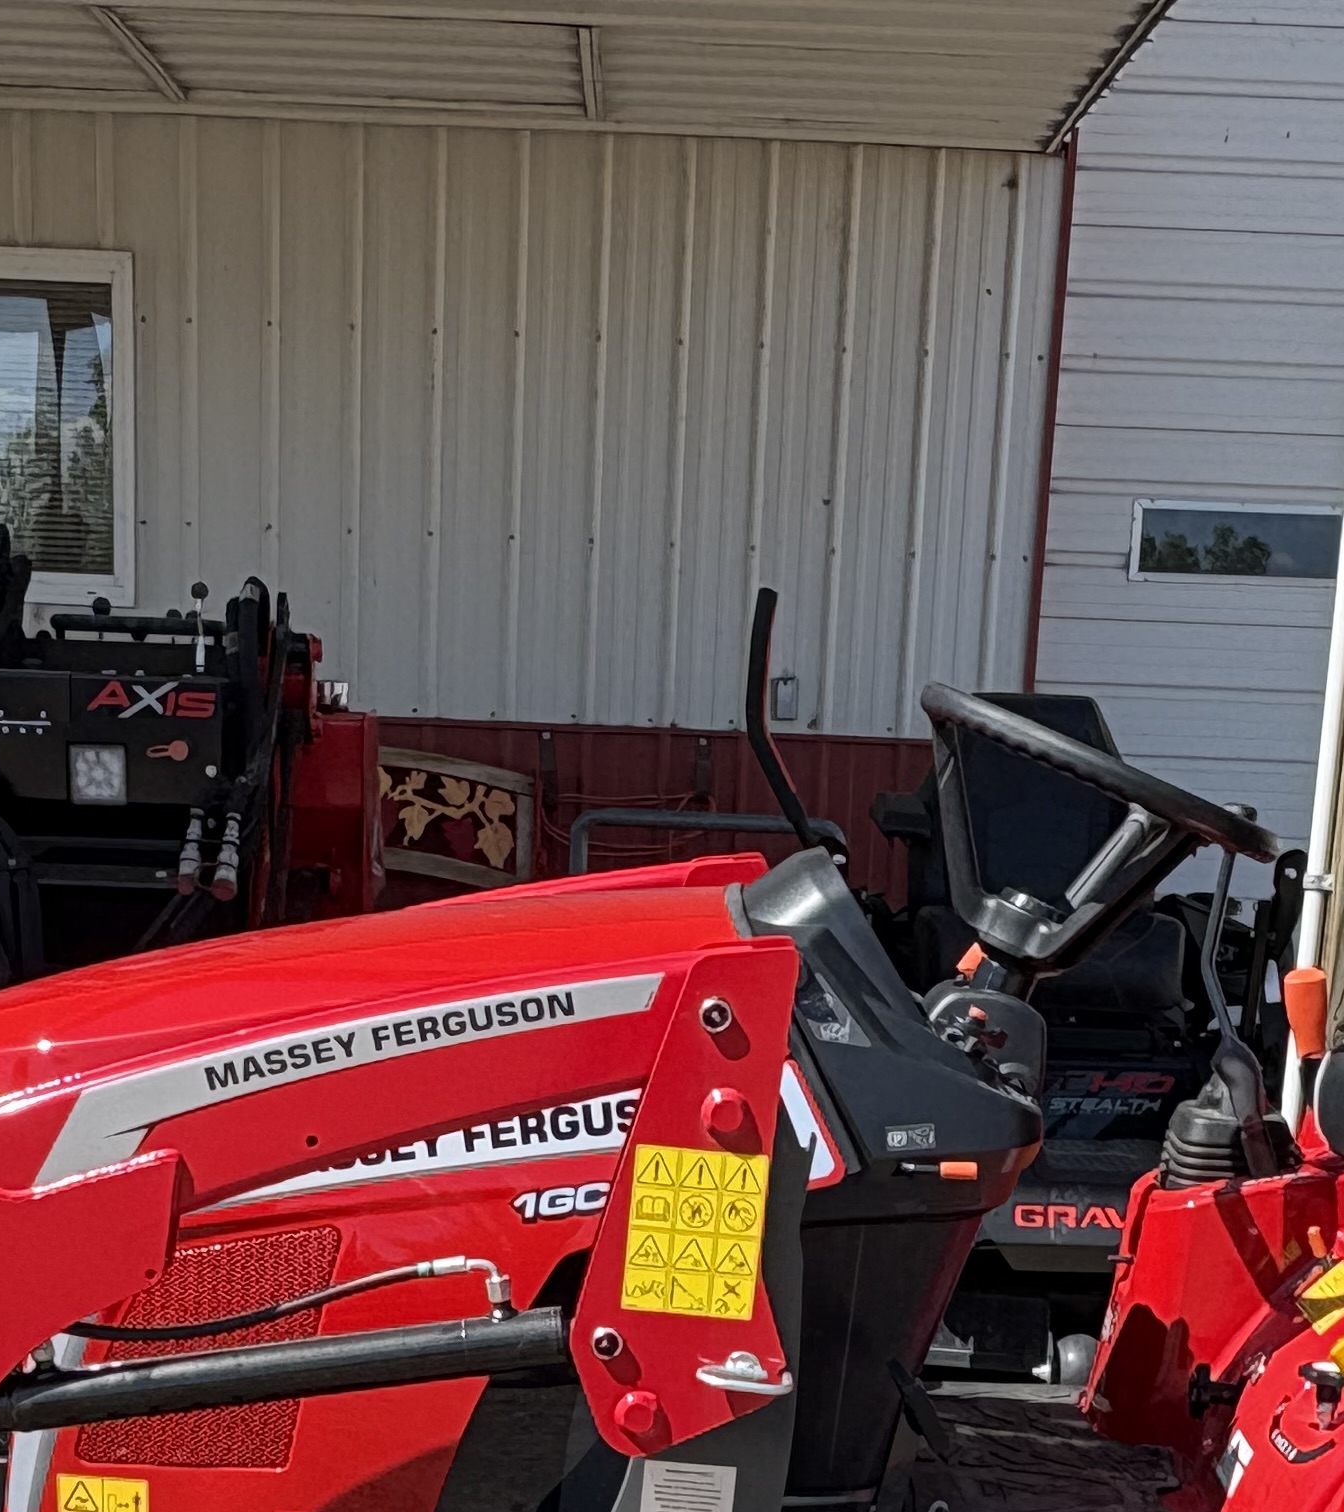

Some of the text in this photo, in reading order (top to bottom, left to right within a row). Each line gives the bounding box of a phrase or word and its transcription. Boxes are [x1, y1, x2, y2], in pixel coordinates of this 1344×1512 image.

[87, 680, 216, 718] AXIS
[204, 991, 576, 1091] MASSEY FERGUSON
[1049, 1097, 1162, 1116] STEALTH
[513, 1182, 610, 1219] 1GC
